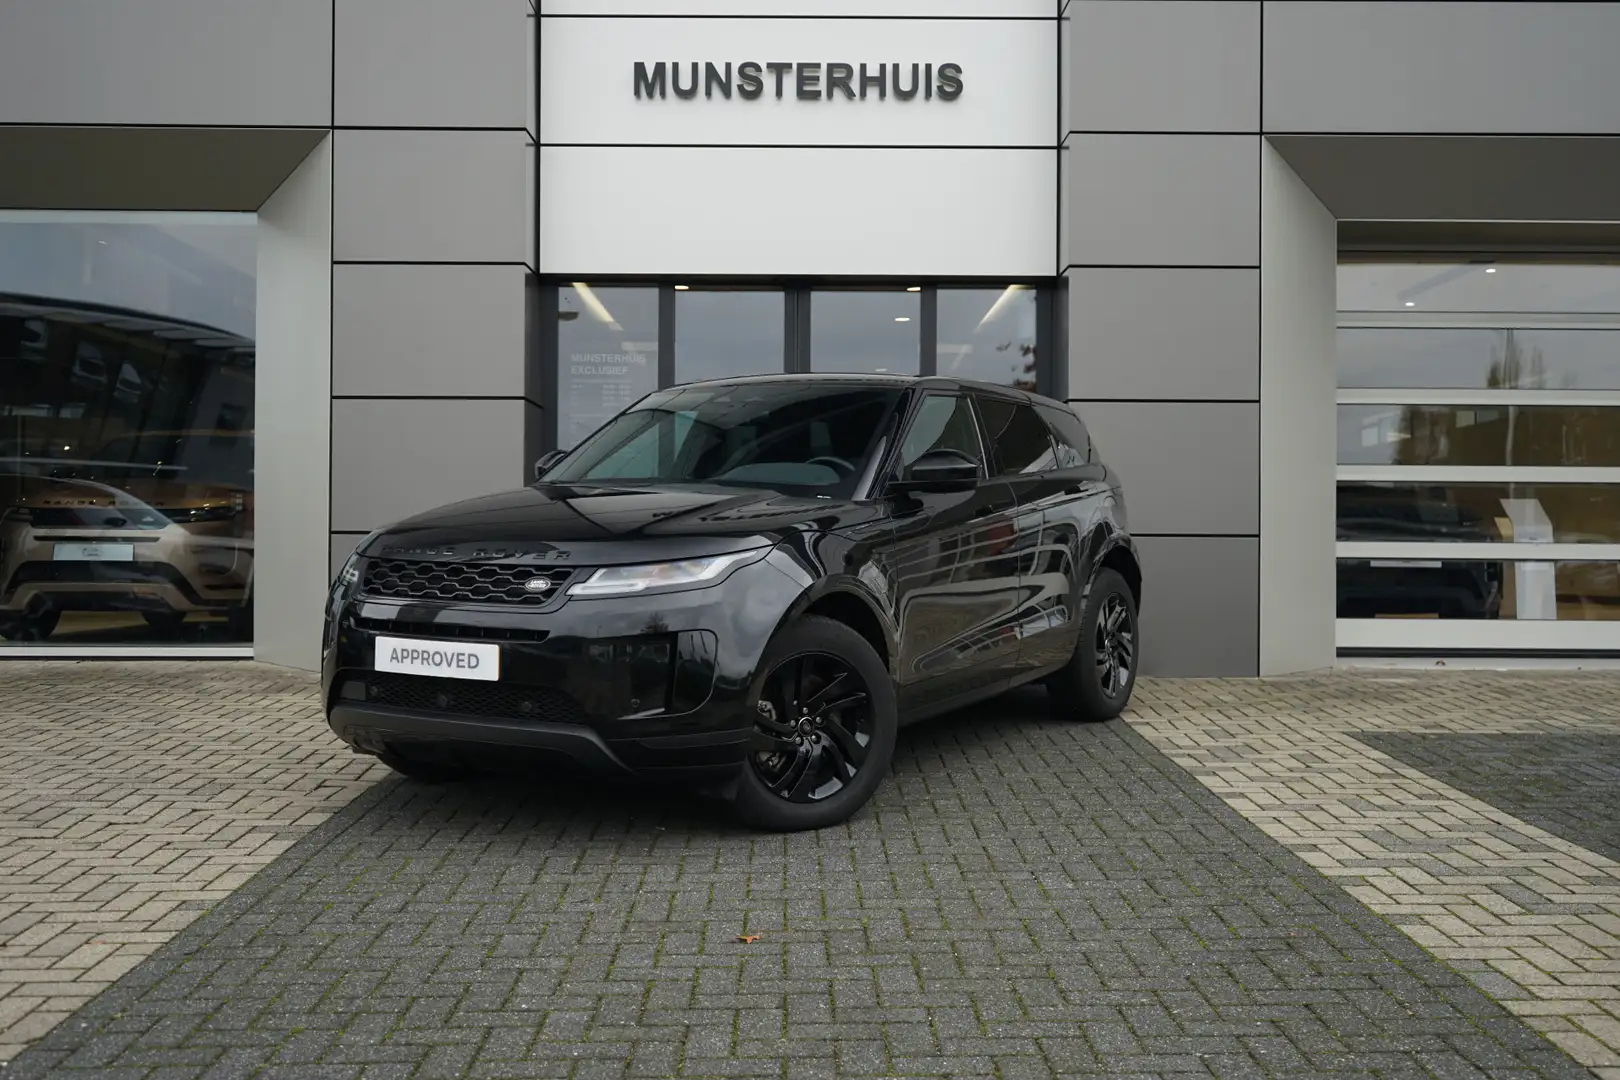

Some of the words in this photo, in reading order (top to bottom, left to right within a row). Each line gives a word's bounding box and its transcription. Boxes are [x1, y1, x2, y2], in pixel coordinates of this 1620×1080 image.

[633, 61, 964, 99] MUNSTERHUIS
[570, 353, 646, 363] MUNSTERHUIS
[570, 366, 629, 375] EXCLUSIEF
[473, 548, 571, 561] ROVER
[389, 647, 481, 669] APPROVED
